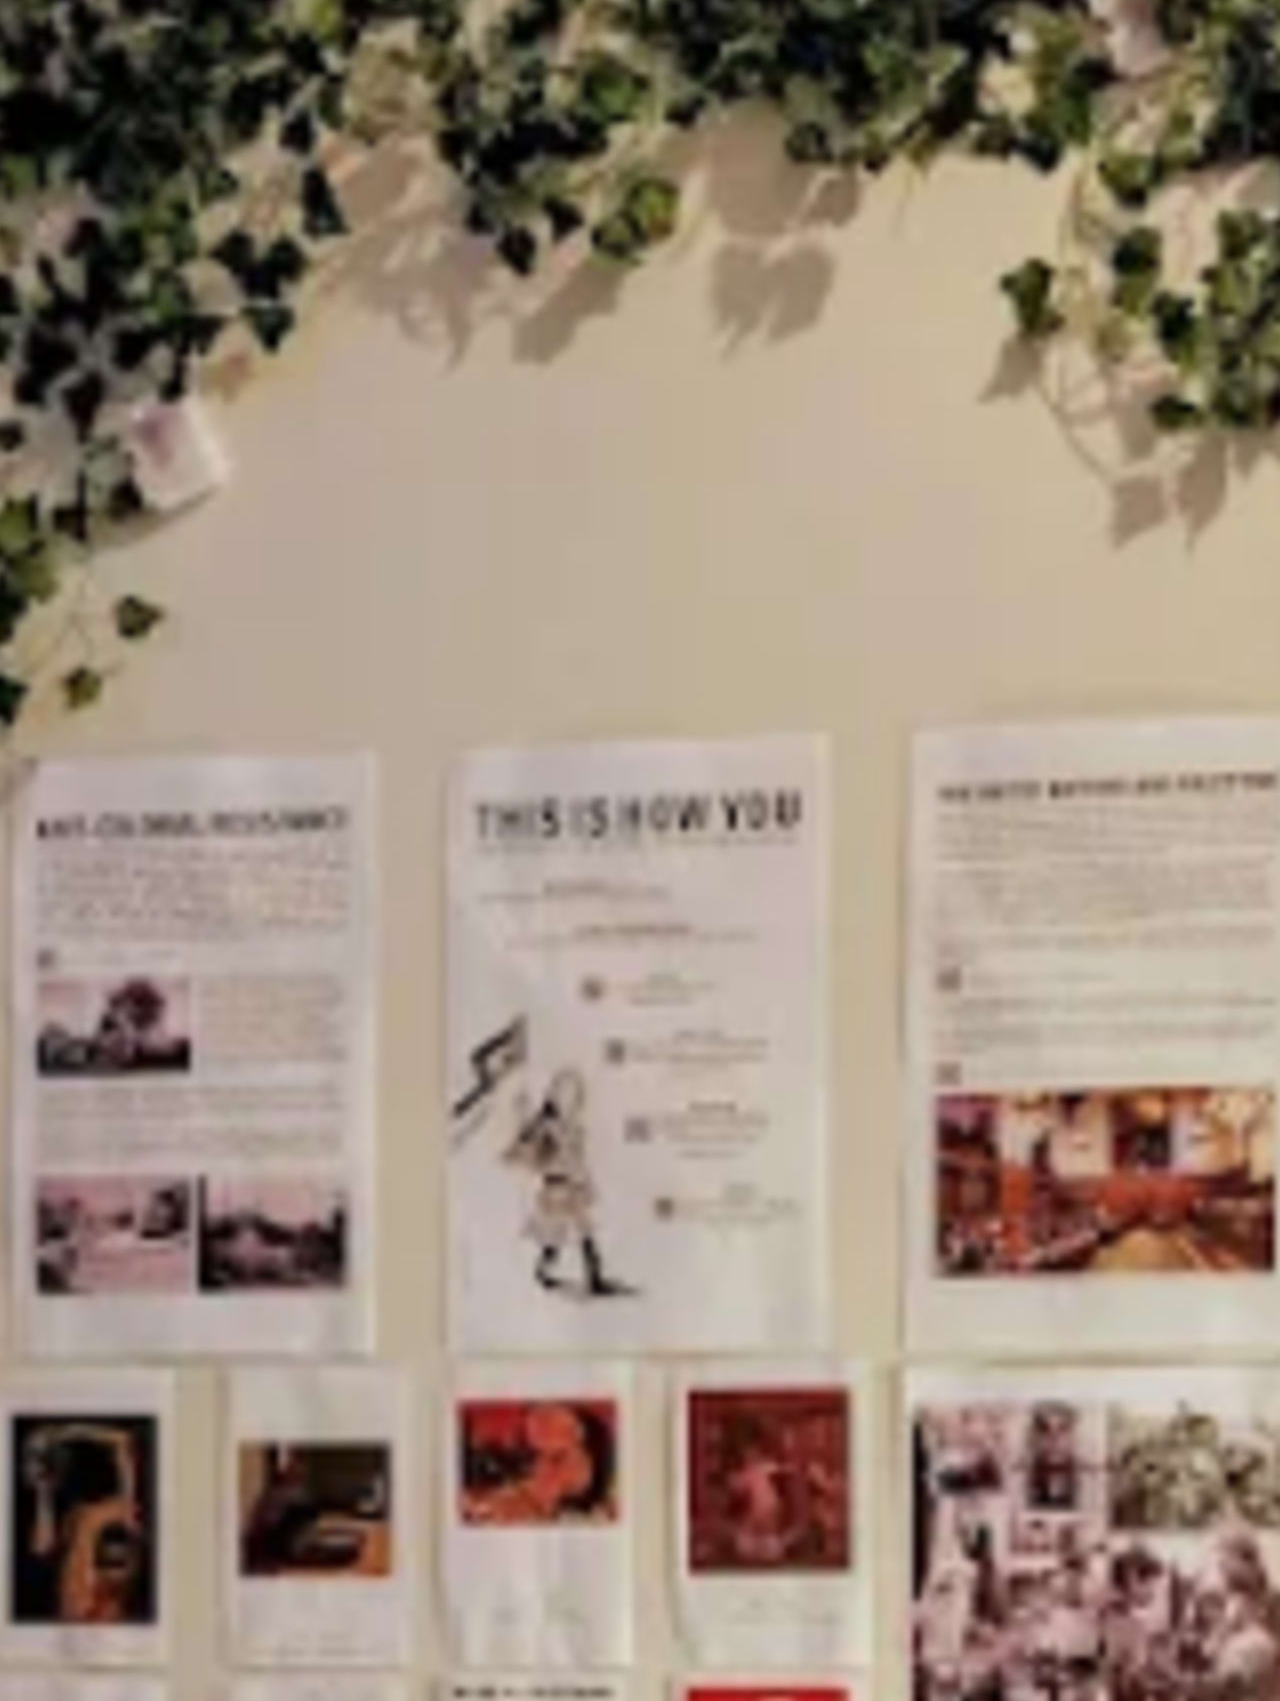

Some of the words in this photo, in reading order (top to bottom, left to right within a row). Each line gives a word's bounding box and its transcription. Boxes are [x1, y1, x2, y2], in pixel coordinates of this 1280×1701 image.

[476, 797, 562, 839] THIS
[572, 795, 609, 838] IS
[618, 793, 710, 836] HOW
[720, 789, 802, 833] YOU
